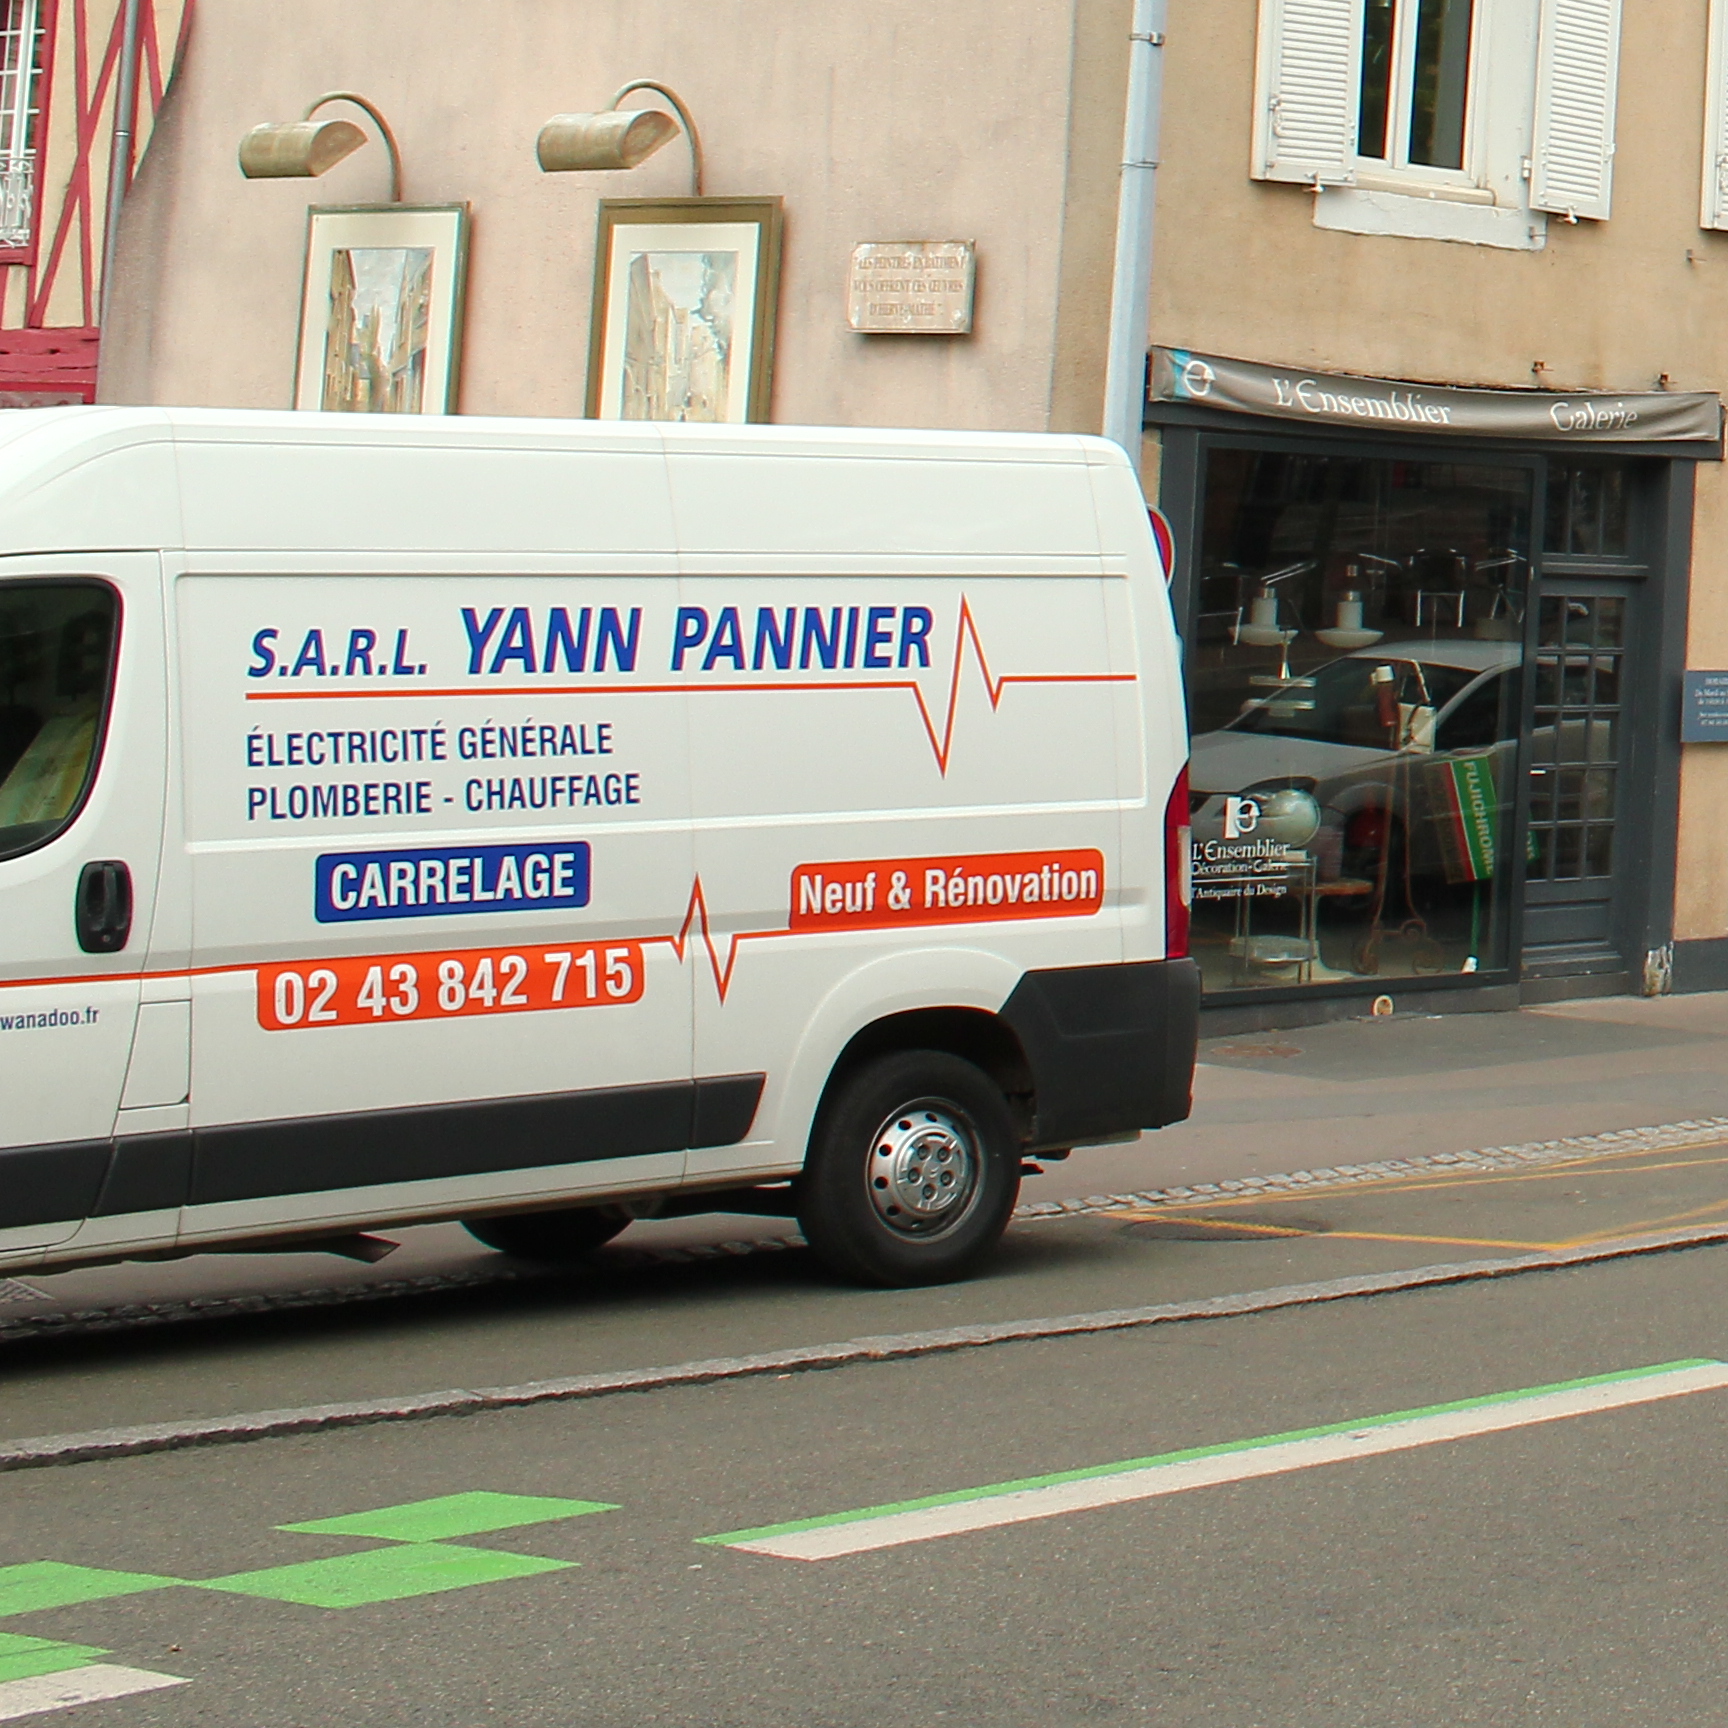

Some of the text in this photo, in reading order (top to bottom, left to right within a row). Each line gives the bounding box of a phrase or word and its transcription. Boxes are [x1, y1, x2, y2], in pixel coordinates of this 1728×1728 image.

[1271, 377, 1639, 432] L'Ensemblier Galerie
[246, 605, 935, 678] S.A.R.L. YANN PANNIER
[246, 717, 615, 767] ÉLECTRICITÉ GÉNÉRALE
[247, 782, 432, 820] PLOMBERIE
[464, 773, 642, 812] CHAUFFAGE
[1463, 760, 1495, 875] FUJICHROME
[1192, 839, 1292, 861] L'Ensemblier
[328, 850, 576, 910] CARRELAGE
[799, 863, 1098, 917] Neuf & Rénovation
[271, 947, 634, 1026] 02 43 842 715
[0, 1006, 100, 1030] wanadoo.fr
